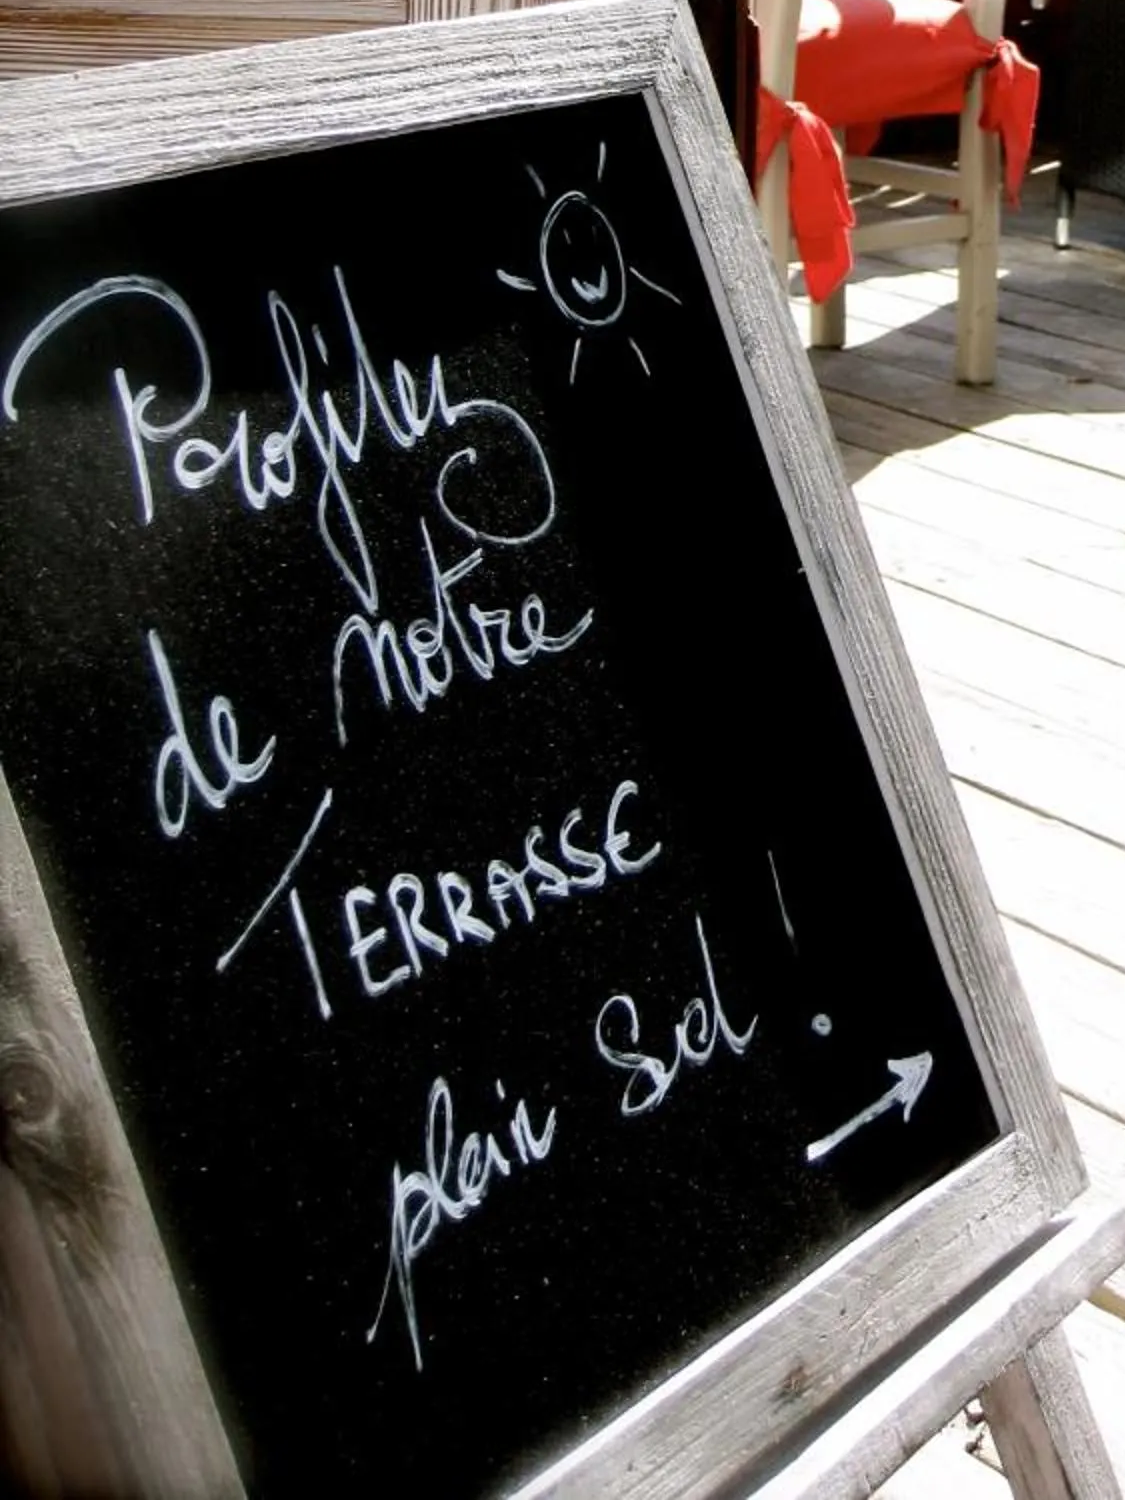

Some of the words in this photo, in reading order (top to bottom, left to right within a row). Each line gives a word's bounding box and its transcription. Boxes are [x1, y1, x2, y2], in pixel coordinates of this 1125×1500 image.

[155, 628, 278, 840] de
[333, 515, 596, 748] notre
[215, 780, 662, 1021] TERRASSE
[365, 1075, 558, 1373] plein
